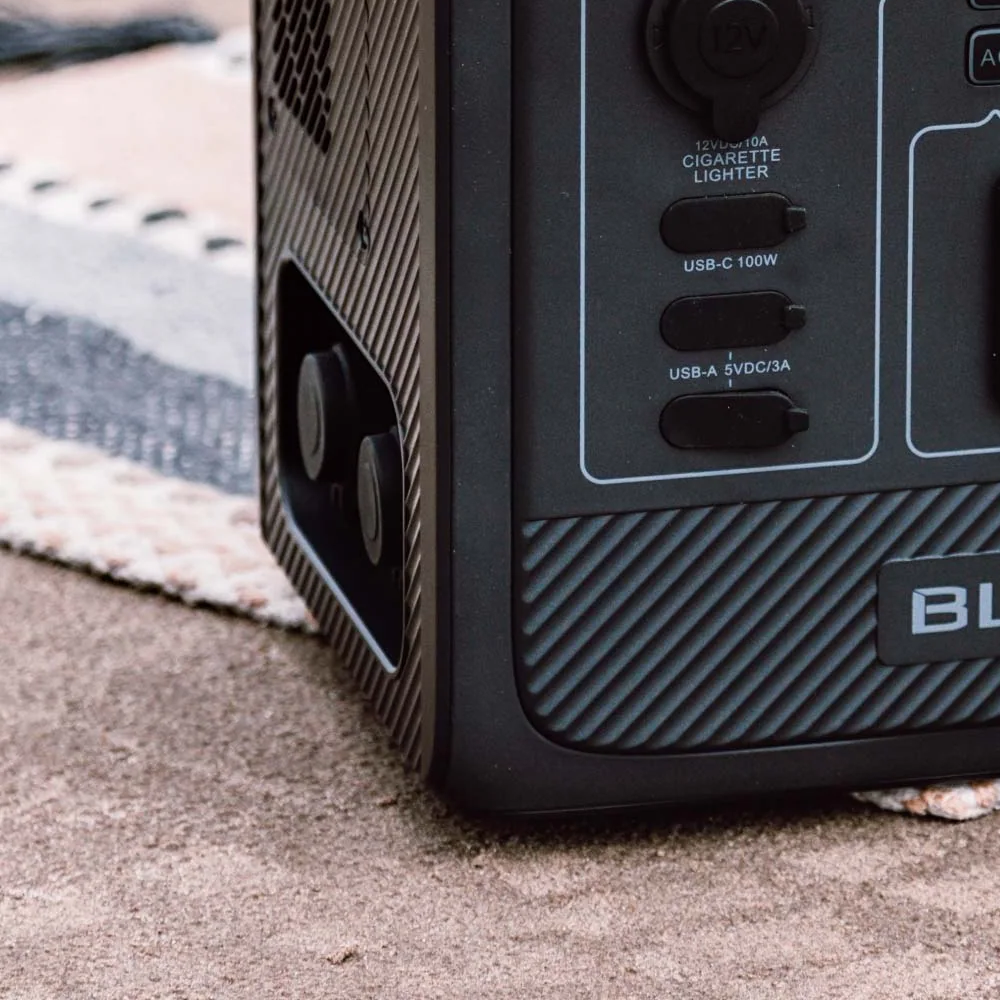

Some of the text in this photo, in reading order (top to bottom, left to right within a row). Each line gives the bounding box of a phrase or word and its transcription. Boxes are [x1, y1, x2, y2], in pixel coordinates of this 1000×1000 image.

[713, 22, 767, 53] 12V
[682, 148, 781, 168] CIGARETTE
[694, 165, 769, 183] LIGHTER
[683, 253, 778, 272] USB-C 100W
[669, 359, 791, 380] USB-A 5VDC/3A
